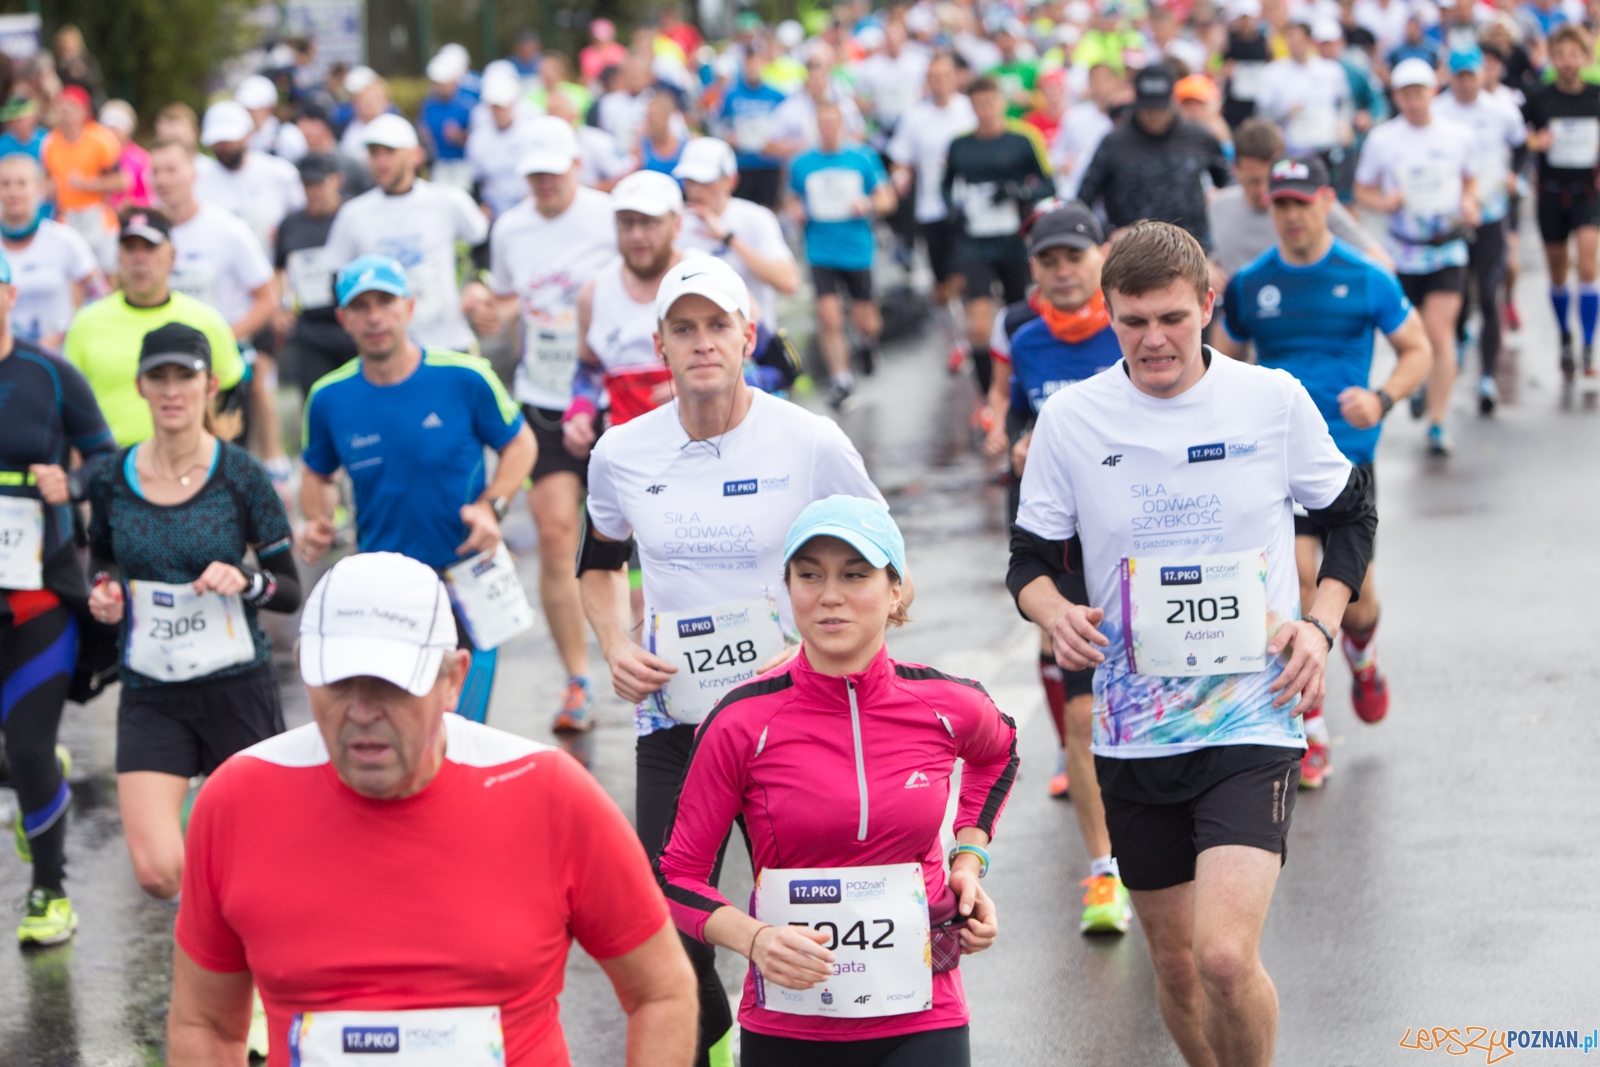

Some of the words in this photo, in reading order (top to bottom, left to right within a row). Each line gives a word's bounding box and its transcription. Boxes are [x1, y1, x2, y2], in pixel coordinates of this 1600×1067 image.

[1101, 454, 1123, 467] 4F
[646, 484, 667, 494] 4F
[1131, 483, 1167, 498] SIŁA
[1142, 494, 1222, 513] ODWAGA
[664, 511, 701, 524] SIŁA
[1131, 508, 1223, 531] SZYBKOŚĆ
[675, 525, 754, 539] ODWAGA
[663, 538, 756, 555] SZYBKOŚĆ
[1134, 540, 1141, 549] 9
[1142, 535, 1199, 550] października
[1202, 534, 1224, 544] 2016
[736, 561, 758, 570] 2016
[1166, 596, 1240, 624] 2103
[149, 611, 206, 640] 2306
[1184, 629, 1225, 641] Adrian
[683, 639, 757, 674] 1248
[699, 669, 754, 690] Krzysztof
[846, 889, 886, 899] maraton
[787, 918, 895, 951] 042
[833, 960, 866, 976] gata
[854, 994, 872, 1004] 4F
